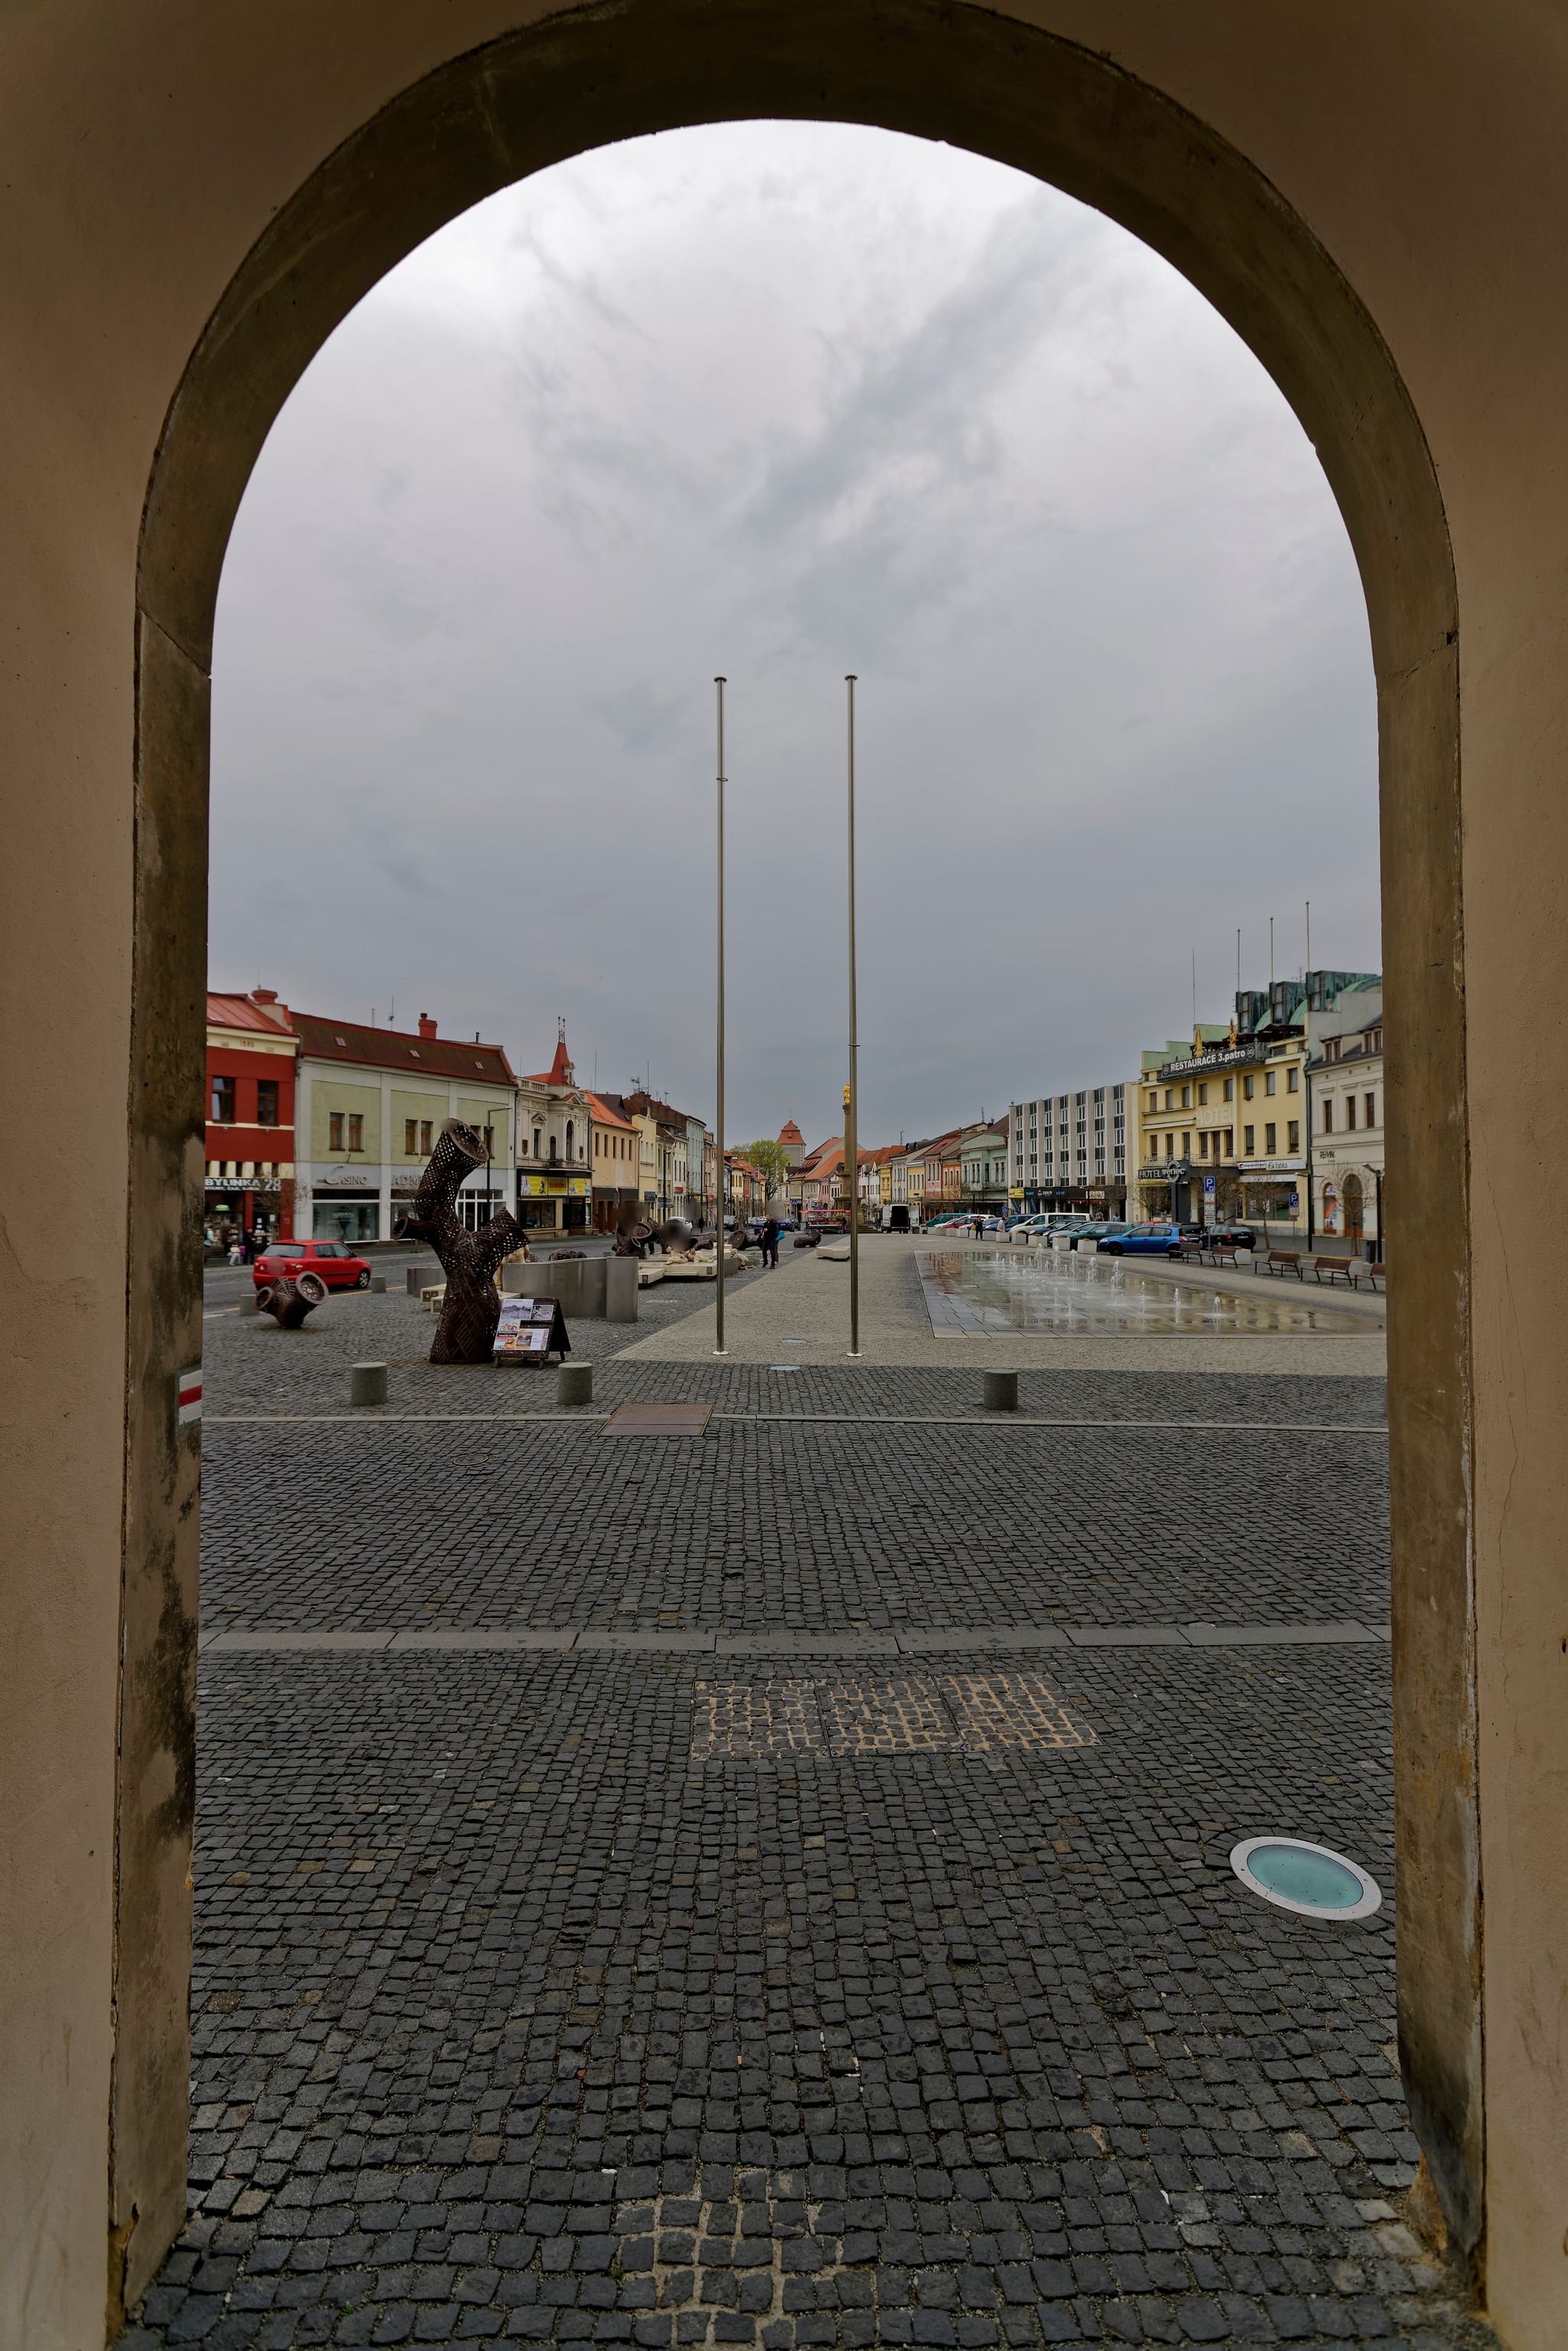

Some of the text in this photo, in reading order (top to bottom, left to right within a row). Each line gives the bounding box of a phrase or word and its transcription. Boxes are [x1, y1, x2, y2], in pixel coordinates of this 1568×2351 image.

[1170, 1050, 1246, 1071] RESTAURACE 3.patro
[1139, 1170, 1161, 1179] HOTEL
[263, 1179, 282, 1192] 28
[1206, 1178, 1214, 1188] P
[1291, 1194, 1298, 1203] P
